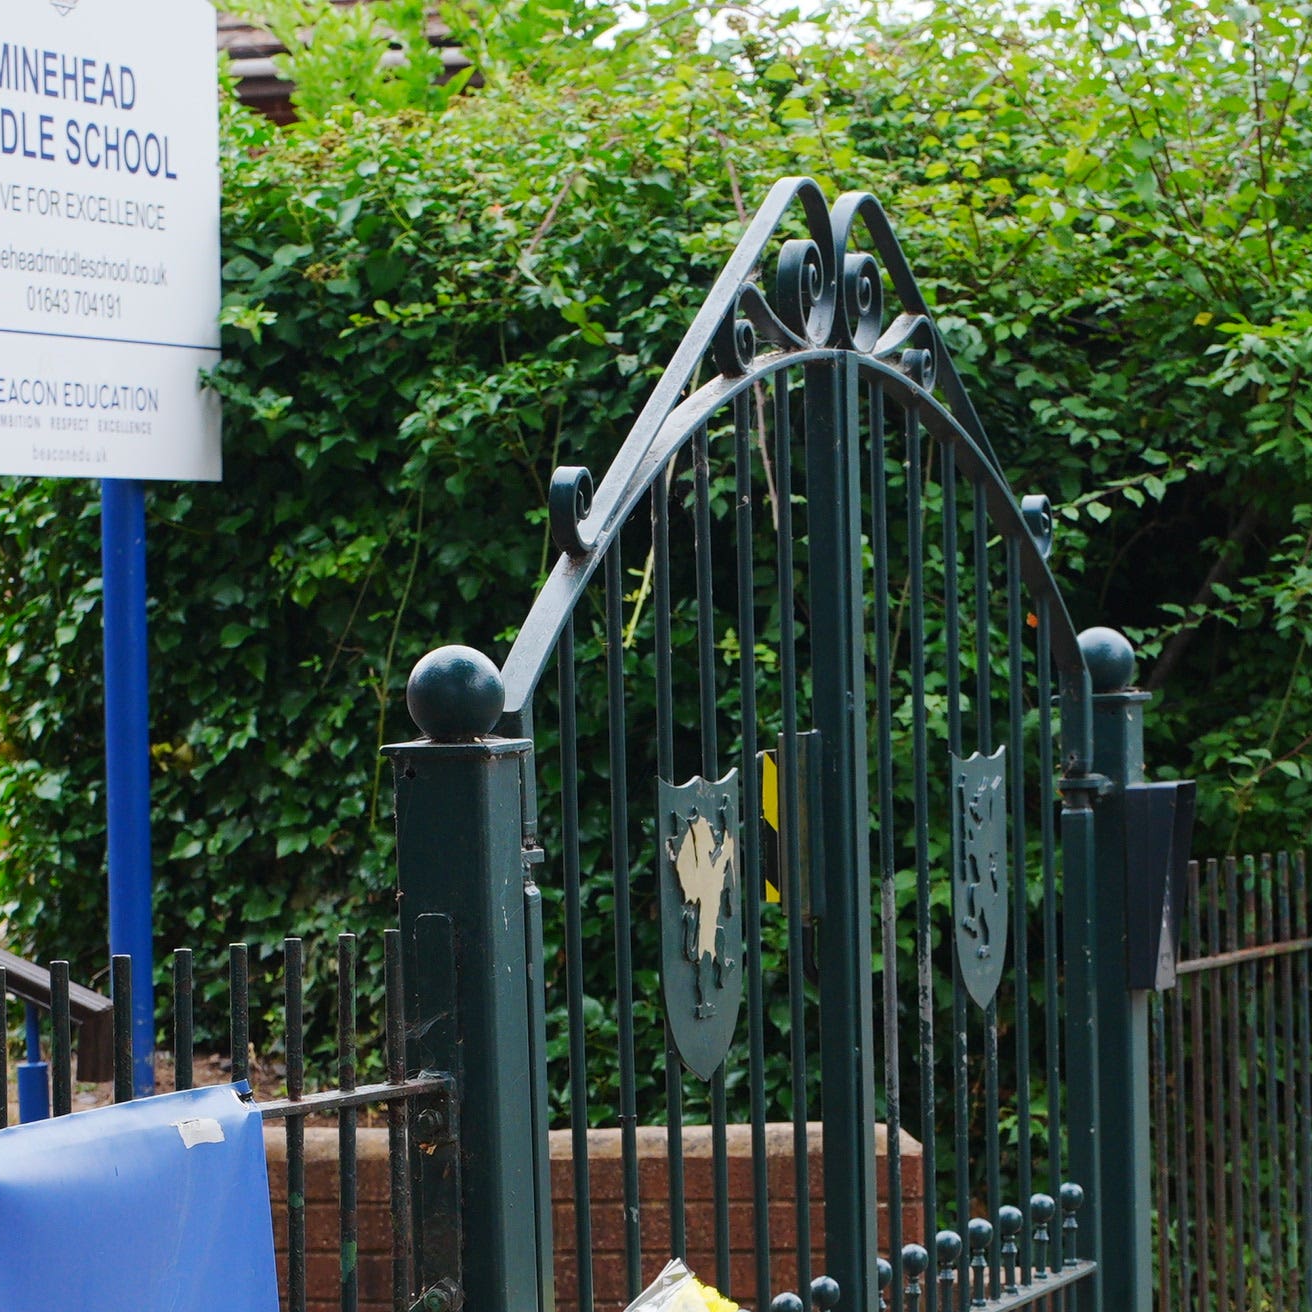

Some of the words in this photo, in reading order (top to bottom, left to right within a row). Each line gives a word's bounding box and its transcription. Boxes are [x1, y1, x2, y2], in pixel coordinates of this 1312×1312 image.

[66, 119, 177, 180] SCHOOL
[27, 186, 61, 218] FOR
[66, 192, 166, 231] EXCELLENCE
[26, 285, 70, 315] 01643
[74, 290, 122, 319] 704191
[64, 382, 159, 412] EDUCATION
[50, 416, 88, 431] RESPECT
[98, 419, 152, 435] EXCELLENCE
